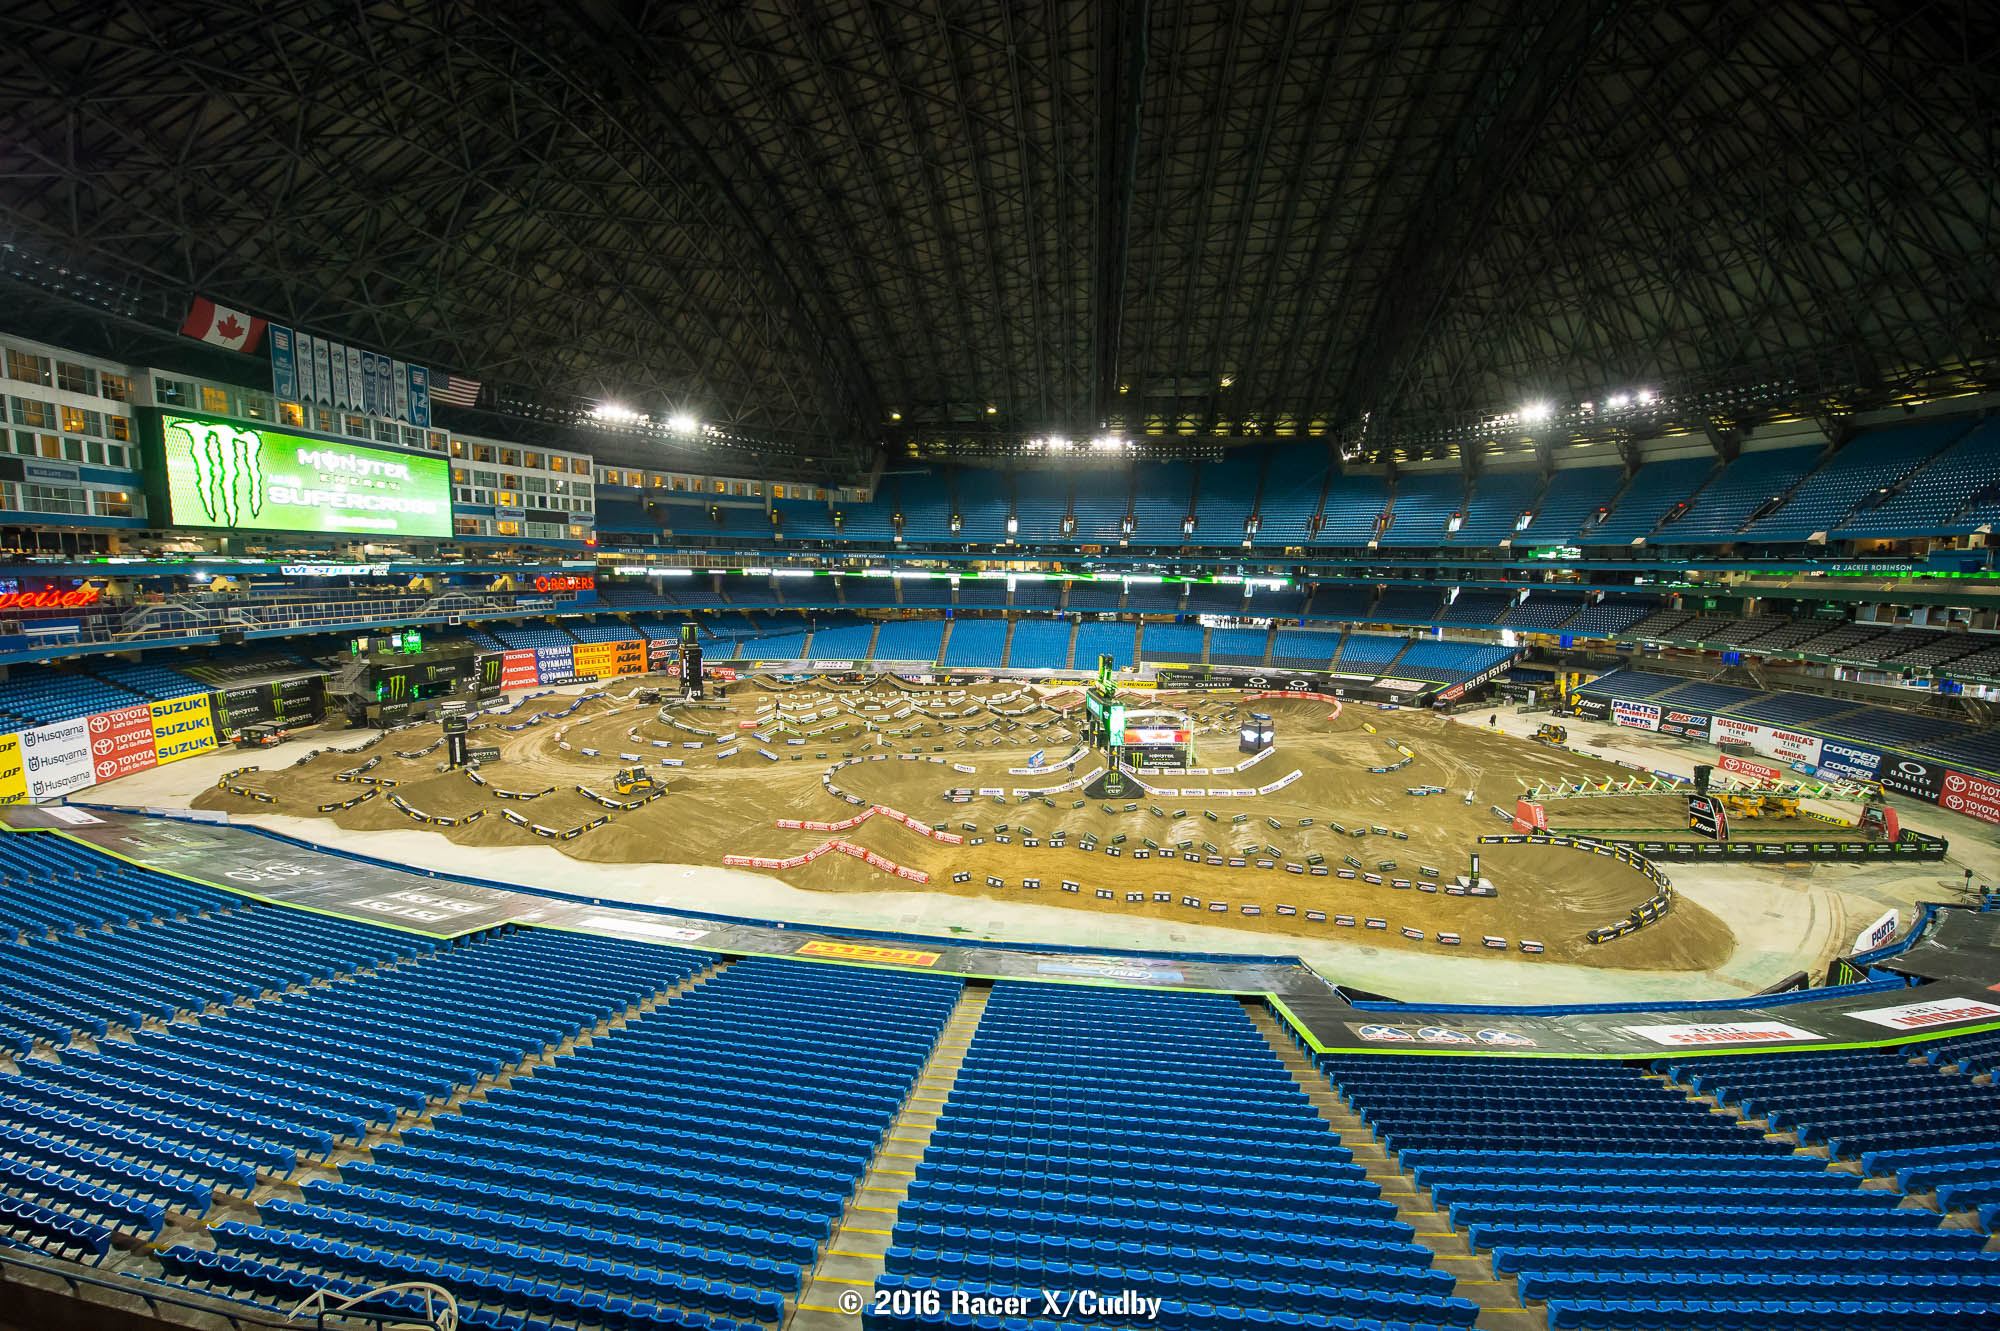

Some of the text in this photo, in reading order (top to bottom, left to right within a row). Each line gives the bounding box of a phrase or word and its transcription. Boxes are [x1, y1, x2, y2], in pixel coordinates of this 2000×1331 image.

[296, 448, 411, 480] MONSTER
[550, 576, 595, 590] ROGERS
[574, 644, 610, 654] PIRELLI
[616, 643, 640, 652] KTM
[650, 639, 678, 648] AMSOIL
[544, 646, 571, 655] YAMAHA
[546, 659, 572, 668] YAMAHA
[575, 656, 610, 666] PIRELLI
[616, 654, 641, 663] KTM
[576, 667, 611, 677] PIRELLI
[617, 665, 642, 674] KTM
[508, 678, 537, 686] HONDA
[226, 688, 257, 698] MONSTER
[152, 698, 207, 718] SUZUKI
[228, 706, 259, 716] MONSTER
[1613, 701, 1659, 714] PARTS
[1613, 707, 1658, 720] UNLIMITED
[109, 708, 149, 722] TOYOTA
[1617, 715, 1651, 726] PARTS
[1667, 712, 1707, 725] AMSOIL
[155, 717, 210, 738] SUZUKI
[1661, 724, 1683, 732] AMSOIL
[1718, 719, 1759, 733] DISCOUNT
[1728, 728, 1746, 736] TIRE
[37, 725, 84, 743] Husqvarna
[114, 728, 152, 744] TOYOTA
[1720, 735, 1752, 746] DISCOUNT
[1772, 730, 1815, 746] AMERICA'S
[158, 736, 214, 758] SUZUKI
[1823, 743, 1880, 763] COOPER
[41, 747, 87, 768] Husqvarna
[117, 749, 155, 766] TOYOTA
[1774, 748, 1806, 761] AMERICA'S
[1741, 762, 1771, 776] TOYOTA
[1824, 761, 1873, 776] COOPER
[1849, 757, 1878, 768] TIRES
[45, 770, 90, 792] Husqvarna
[1890, 769, 1931, 785] OAKLEY
[1895, 782, 1938, 799] OAKLEY
[1968, 790, 1980, 799] Let's
[1969, 780, 2000, 799] TOYOT
[1966, 800, 1999, 817] TOYOTA
[1806, 812, 1841, 824] SUZUKI
[1696, 823, 1716, 833] thor
[1872, 917, 1895, 946] PARTS
[1891, 1006, 1999, 1027] DISCOUNT
[1670, 1030, 1795, 1044] AMERICA'S
